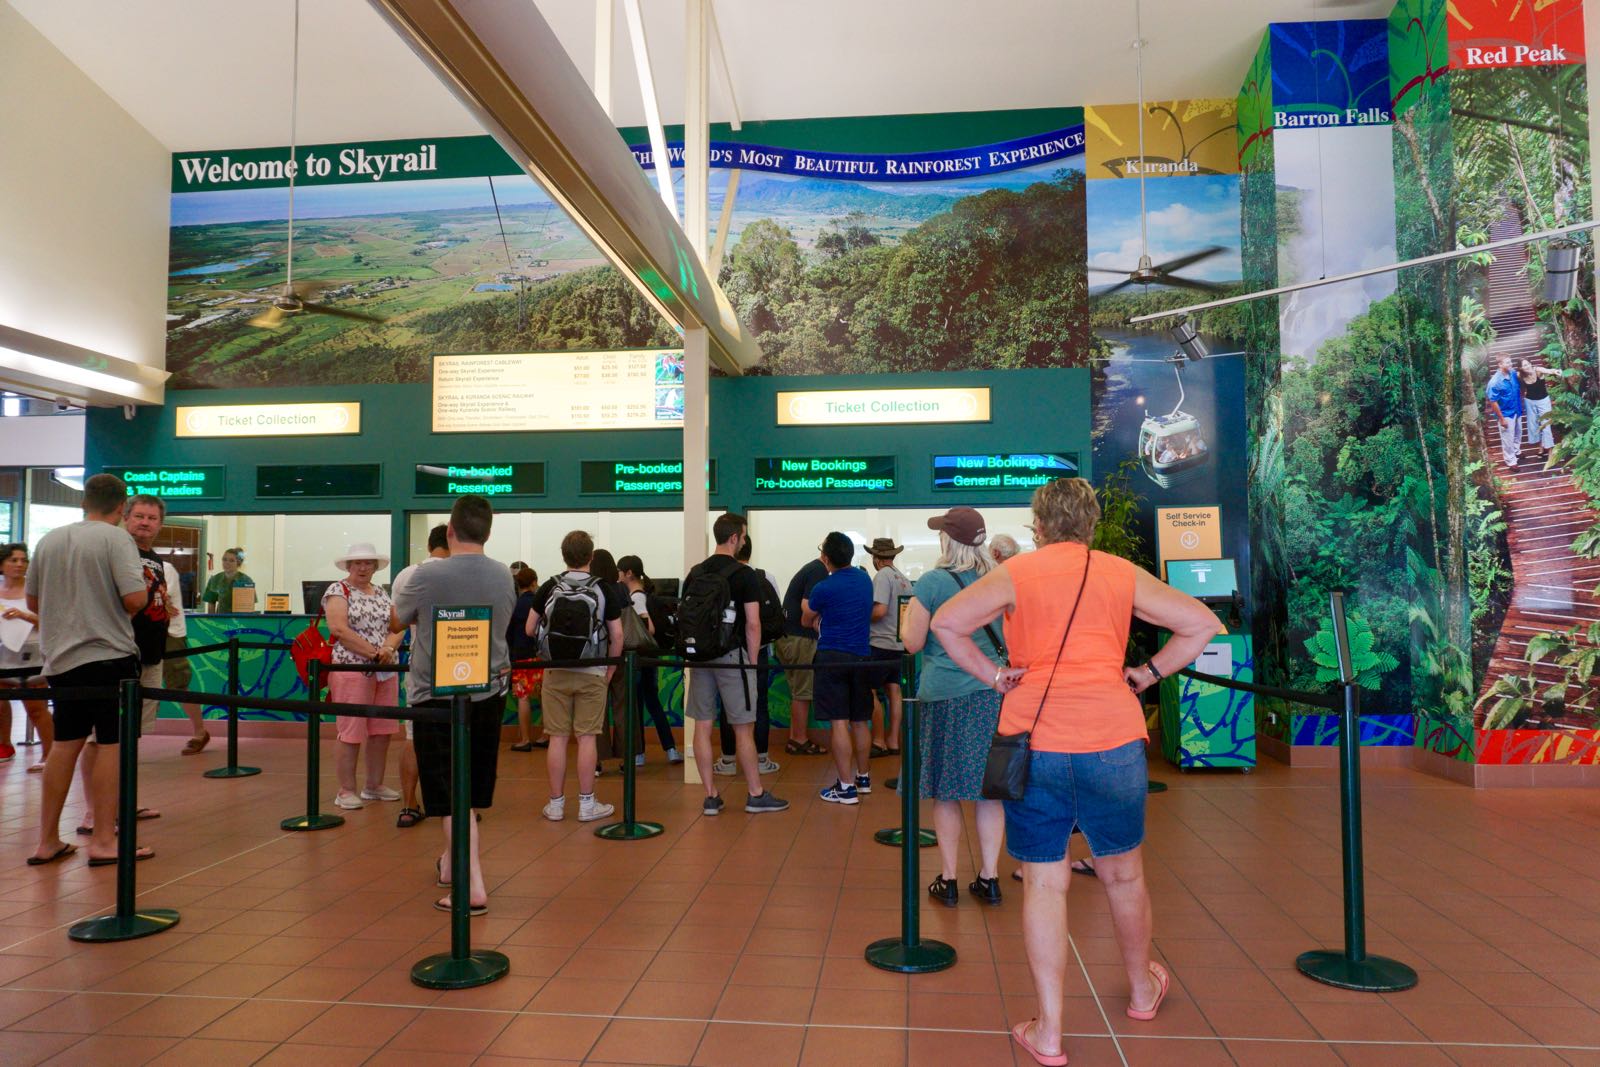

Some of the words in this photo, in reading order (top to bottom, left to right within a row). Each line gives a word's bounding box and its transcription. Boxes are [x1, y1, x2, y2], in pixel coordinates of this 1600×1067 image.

[1465, 47, 1511, 65] Red
[1514, 44, 1567, 63] Peak
[1273, 110, 1340, 128] Barron
[1345, 107, 1390, 125] Falls
[795, 154, 878, 175] BEAUTIFUL
[885, 154, 981, 176] RAINFOREST
[988, 131, 1085, 167] EXPERIENCE
[178, 156, 298, 185] Welcome
[304, 152, 331, 177] to
[338, 144, 437, 182] Skyrail
[824, 400, 866, 413] Ticket
[870, 399, 940, 412] Collection
[217, 414, 252, 427] Ticket
[256, 413, 317, 426] Collection
[615, 463, 682, 475] Pre-booked
[781, 460, 809, 471] New
[810, 459, 867, 473] Bookings
[956, 456, 984, 468] New
[987, 455, 1045, 469] Bookings
[1047, 455, 1057, 467] &
[123, 471, 158, 483] Coach
[159, 470, 205, 484] Captains
[447, 465, 513, 477] Pre-booked
[615, 479, 682, 493] Passengers
[755, 477, 823, 488] Pre-booked
[825, 476, 894, 490] Passengers
[953, 474, 1000, 487] General
[160, 485, 203, 497] Leaders
[448, 482, 513, 495] Passengers
[438, 609, 465, 619] Skyrail
